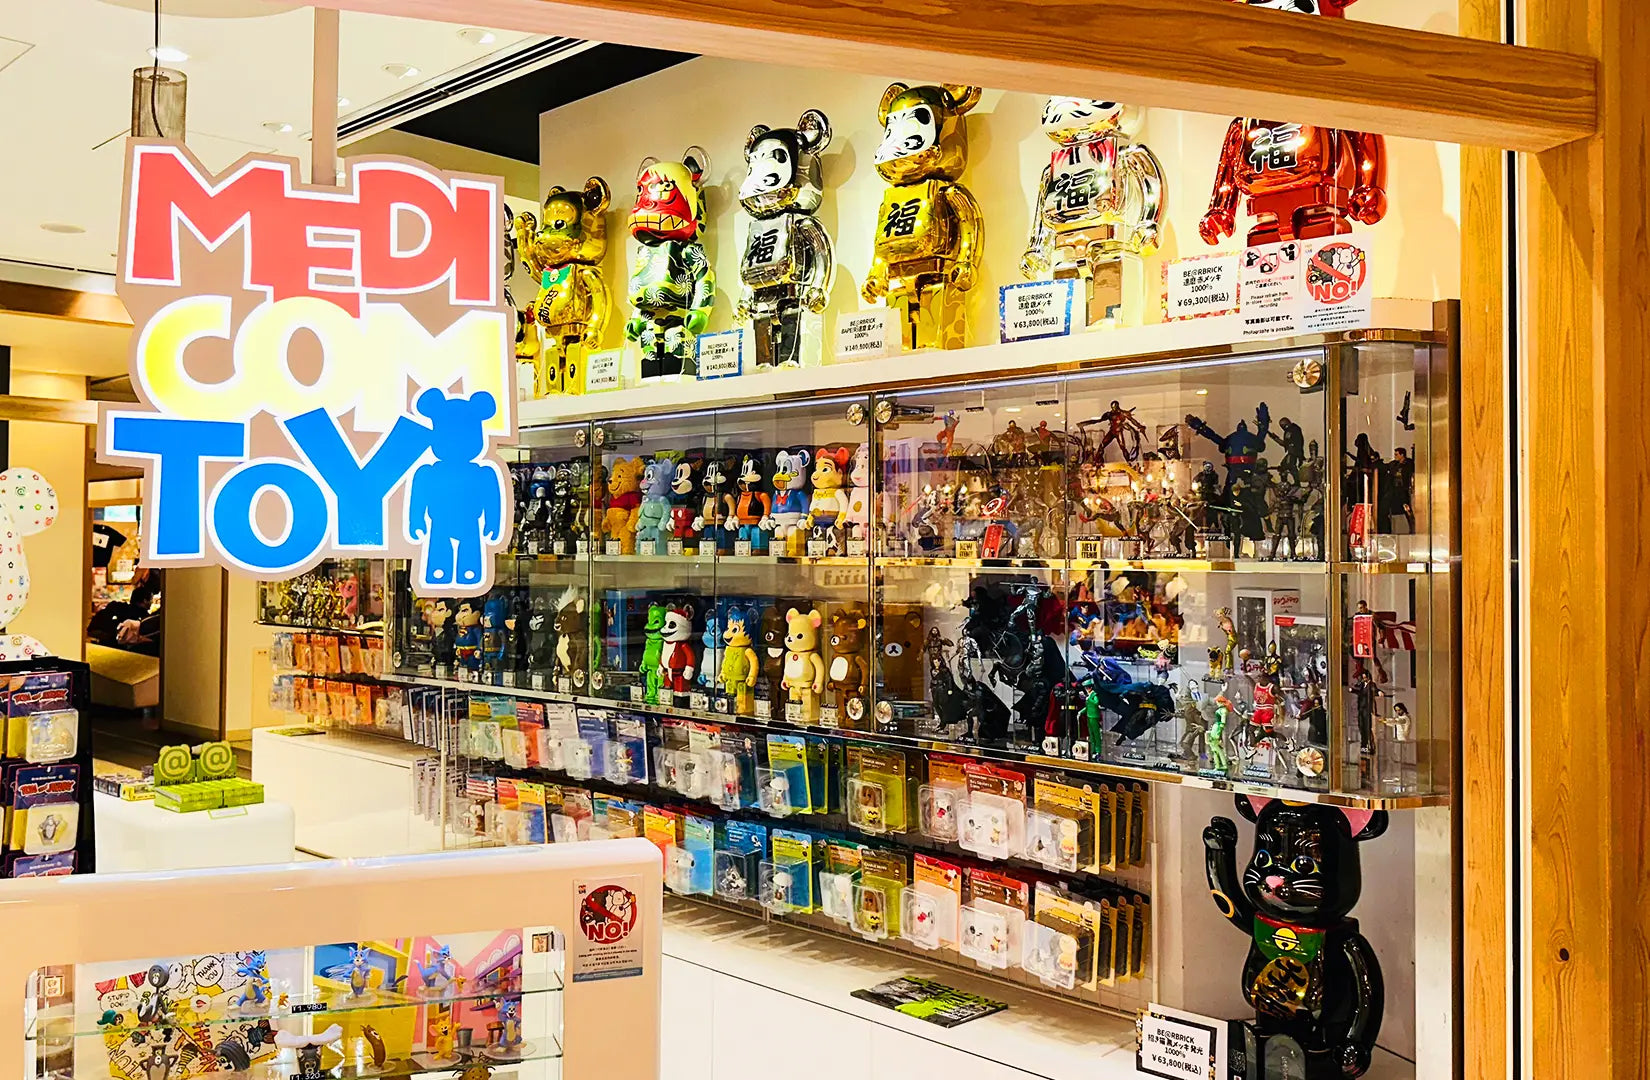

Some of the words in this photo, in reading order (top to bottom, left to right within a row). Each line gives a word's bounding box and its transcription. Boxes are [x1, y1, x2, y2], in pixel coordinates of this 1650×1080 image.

[1054, 168, 1096, 212] 福
[129, 148, 494, 318] MEDI
[883, 198, 921, 238] 福
[749, 228, 780, 265] 福
[1314, 280, 1358, 301] NO!
[138, 297, 508, 433] COM
[112, 407, 434, 568] TOY
[587, 921, 630, 941] NO!
[197, 960, 218, 980] THANK
[206, 968, 219, 982] YOU
